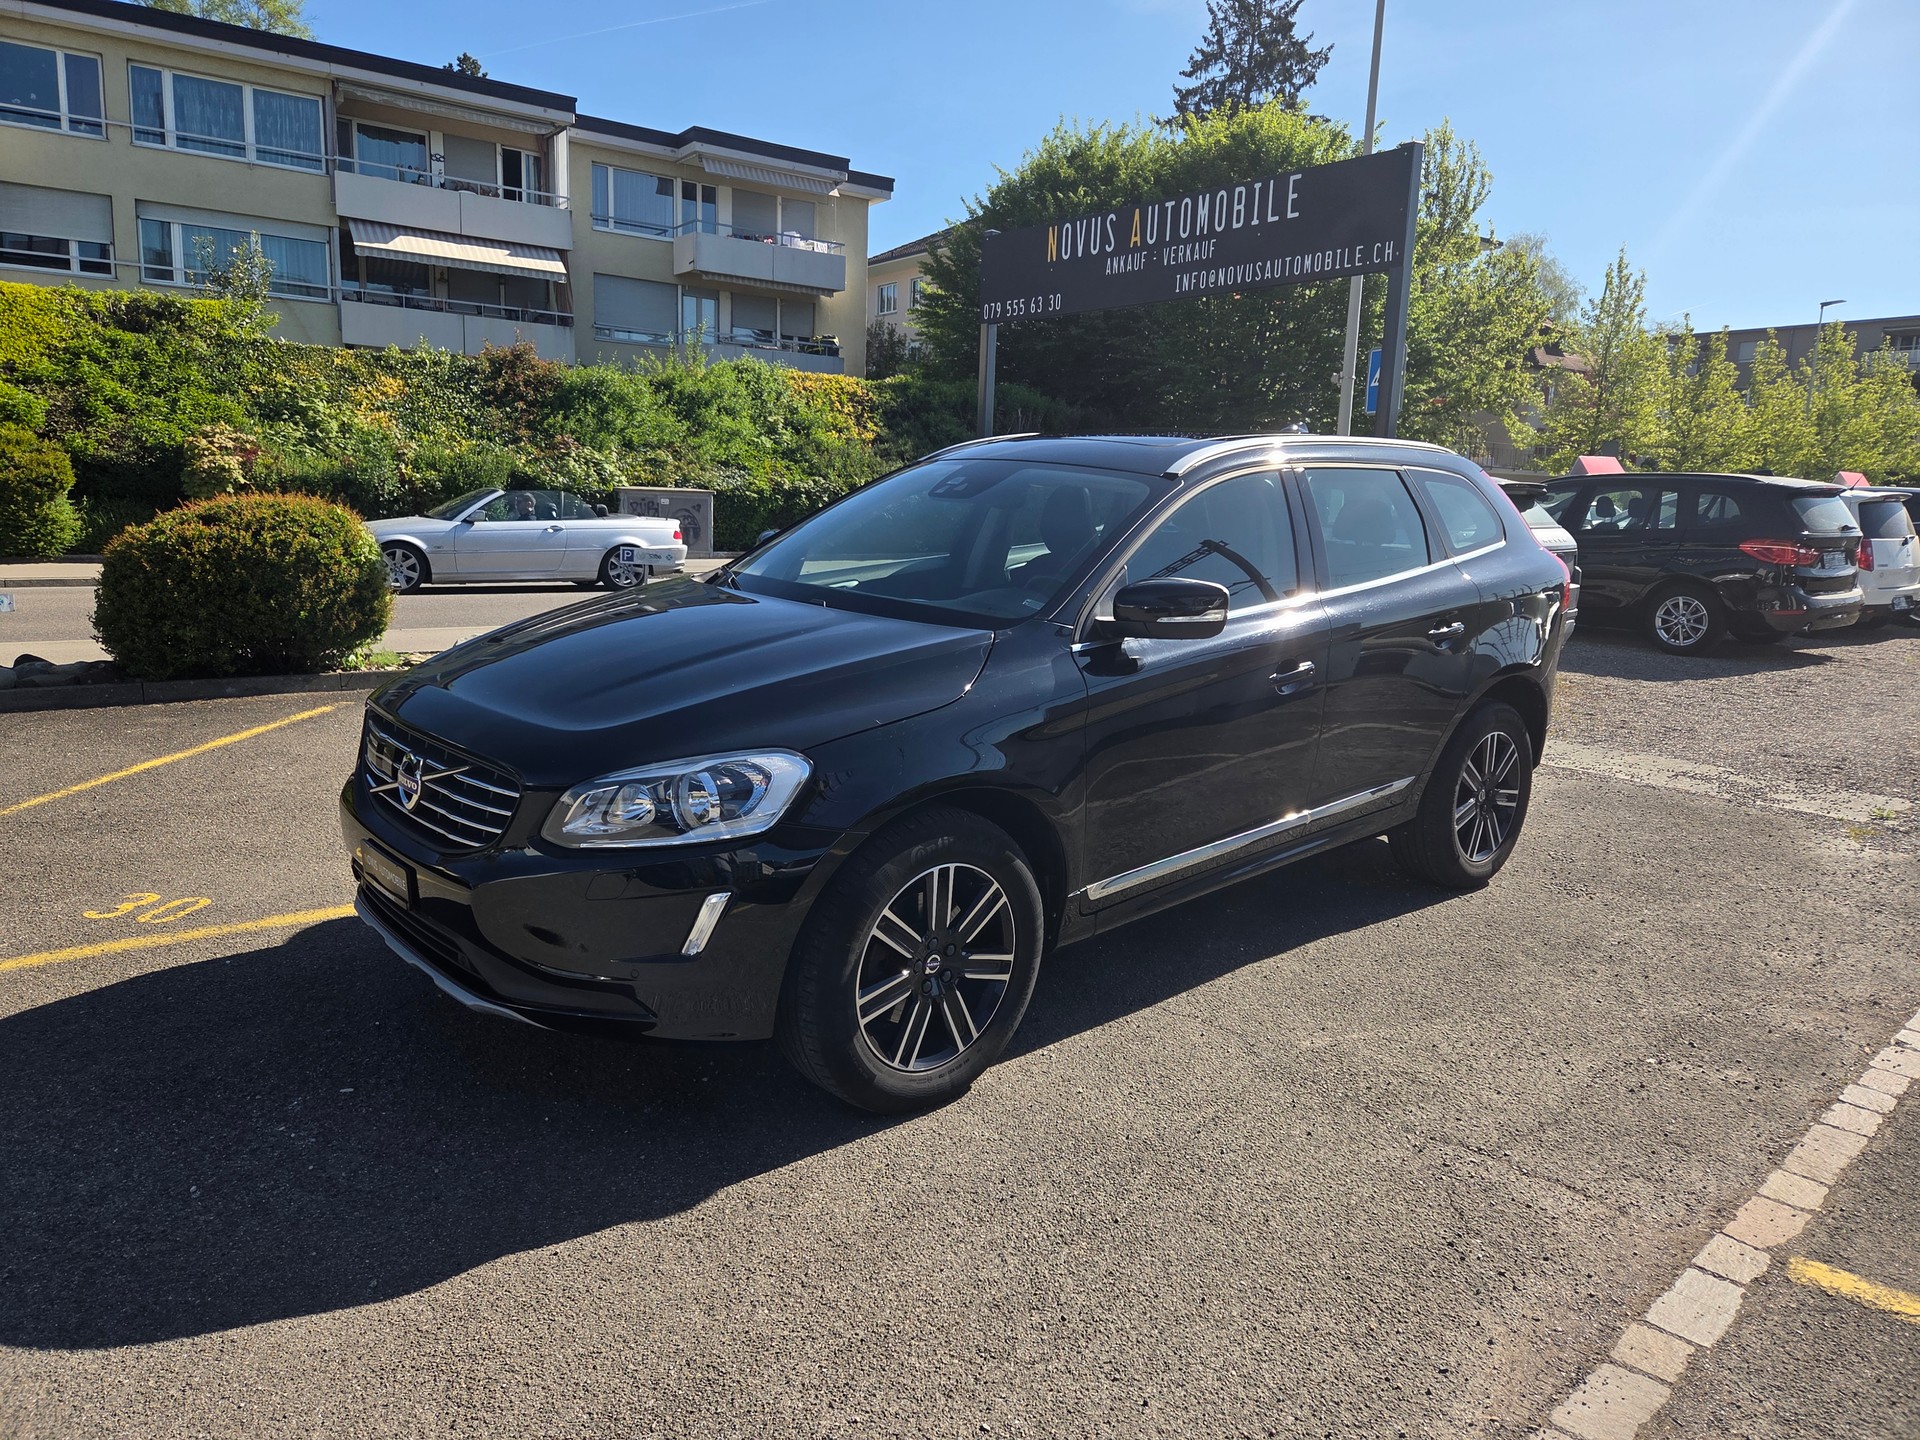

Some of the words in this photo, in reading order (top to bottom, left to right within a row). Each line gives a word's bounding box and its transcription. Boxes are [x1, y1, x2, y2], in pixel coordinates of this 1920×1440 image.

[1047, 213, 1117, 263] NOVUS
[1130, 173, 1302, 248] AUTOMOBILE
[1105, 251, 1148, 276] ANKAUF
[1163, 239, 1217, 266] VERKAUF
[1175, 240, 1394, 293] INFO@NOVUSAUTOMOBILE.CH
[983, 302, 1001, 320] 079
[1006, 298, 1025, 317] 555
[1030, 296, 1043, 314] 63
[1048, 293, 1061, 311] 30
[82, 892, 212, 924] 30
